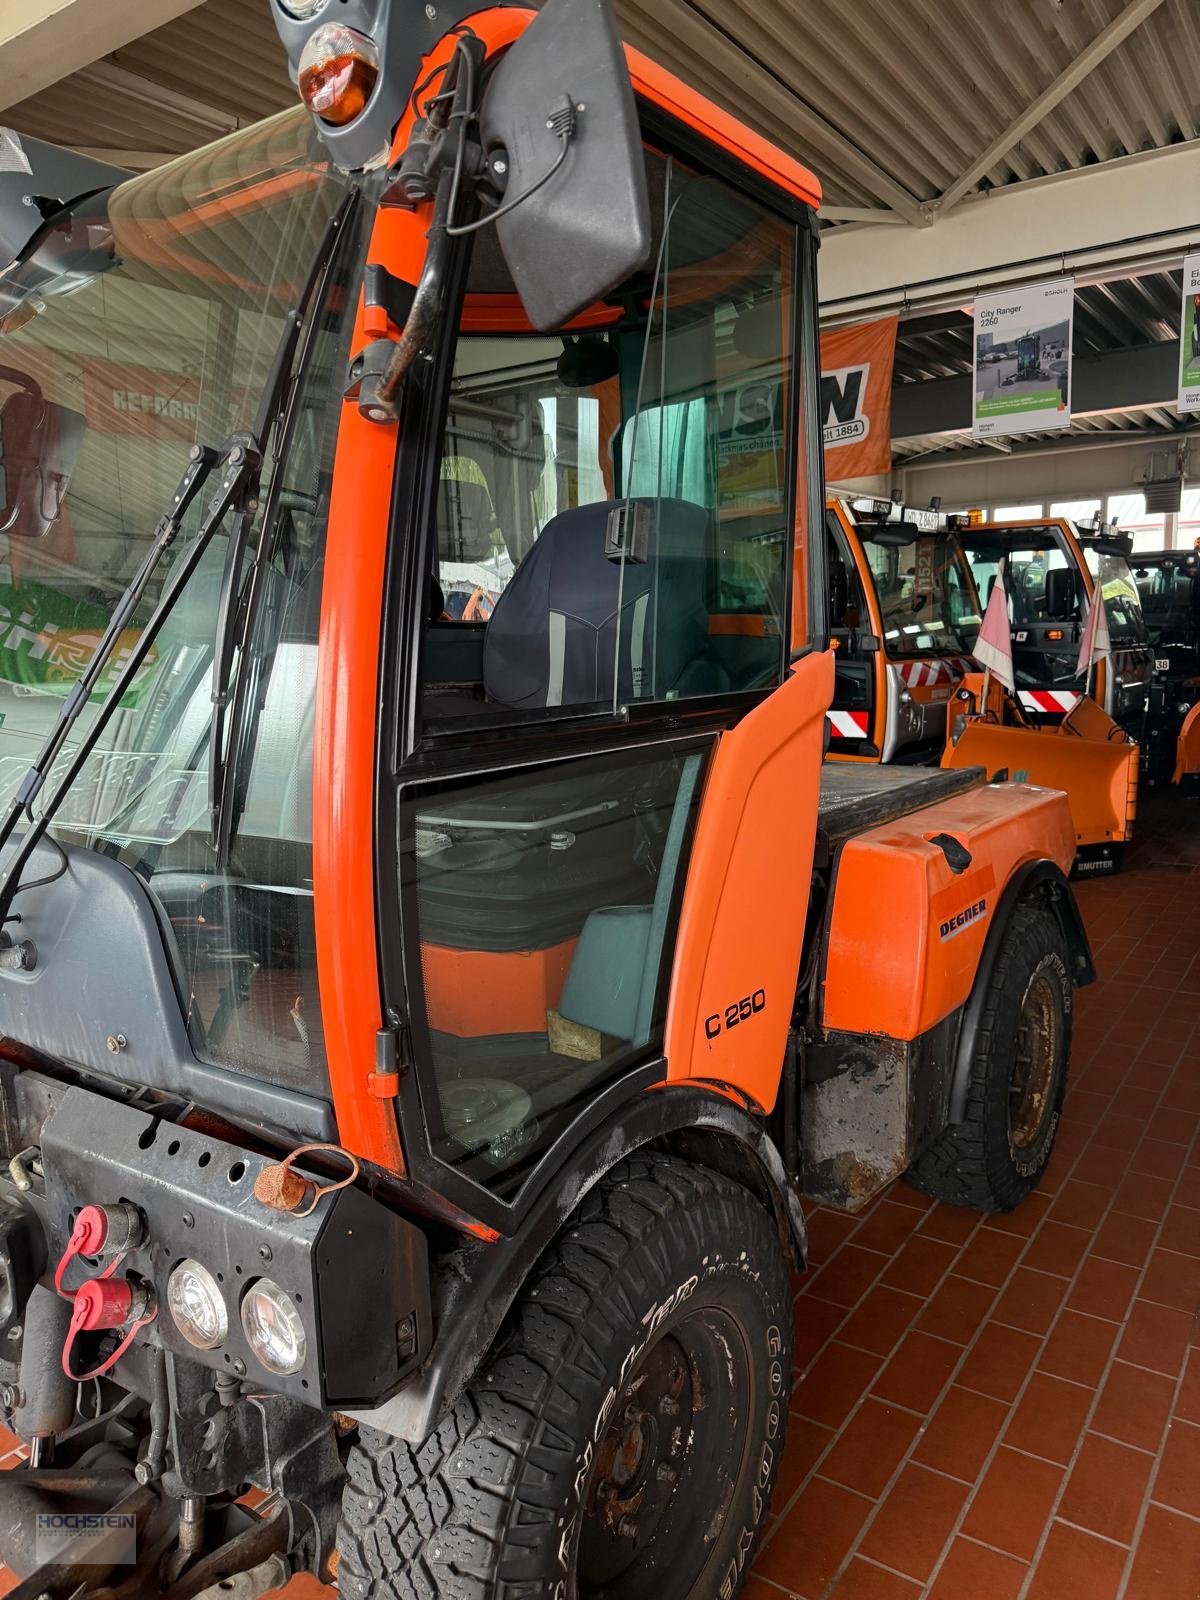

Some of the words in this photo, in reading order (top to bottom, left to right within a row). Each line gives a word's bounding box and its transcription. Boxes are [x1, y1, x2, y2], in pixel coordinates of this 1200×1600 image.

[980, 309, 995, 320] City
[996, 305, 1022, 317] Ranger
[980, 317, 999, 328] 2260
[835, 425, 860, 438] 1884
[1156, 659, 1168, 670] 38
[939, 899, 987, 937] DEGNER
[704, 1013, 722, 1040] C
[724, 988, 766, 1030] 250
